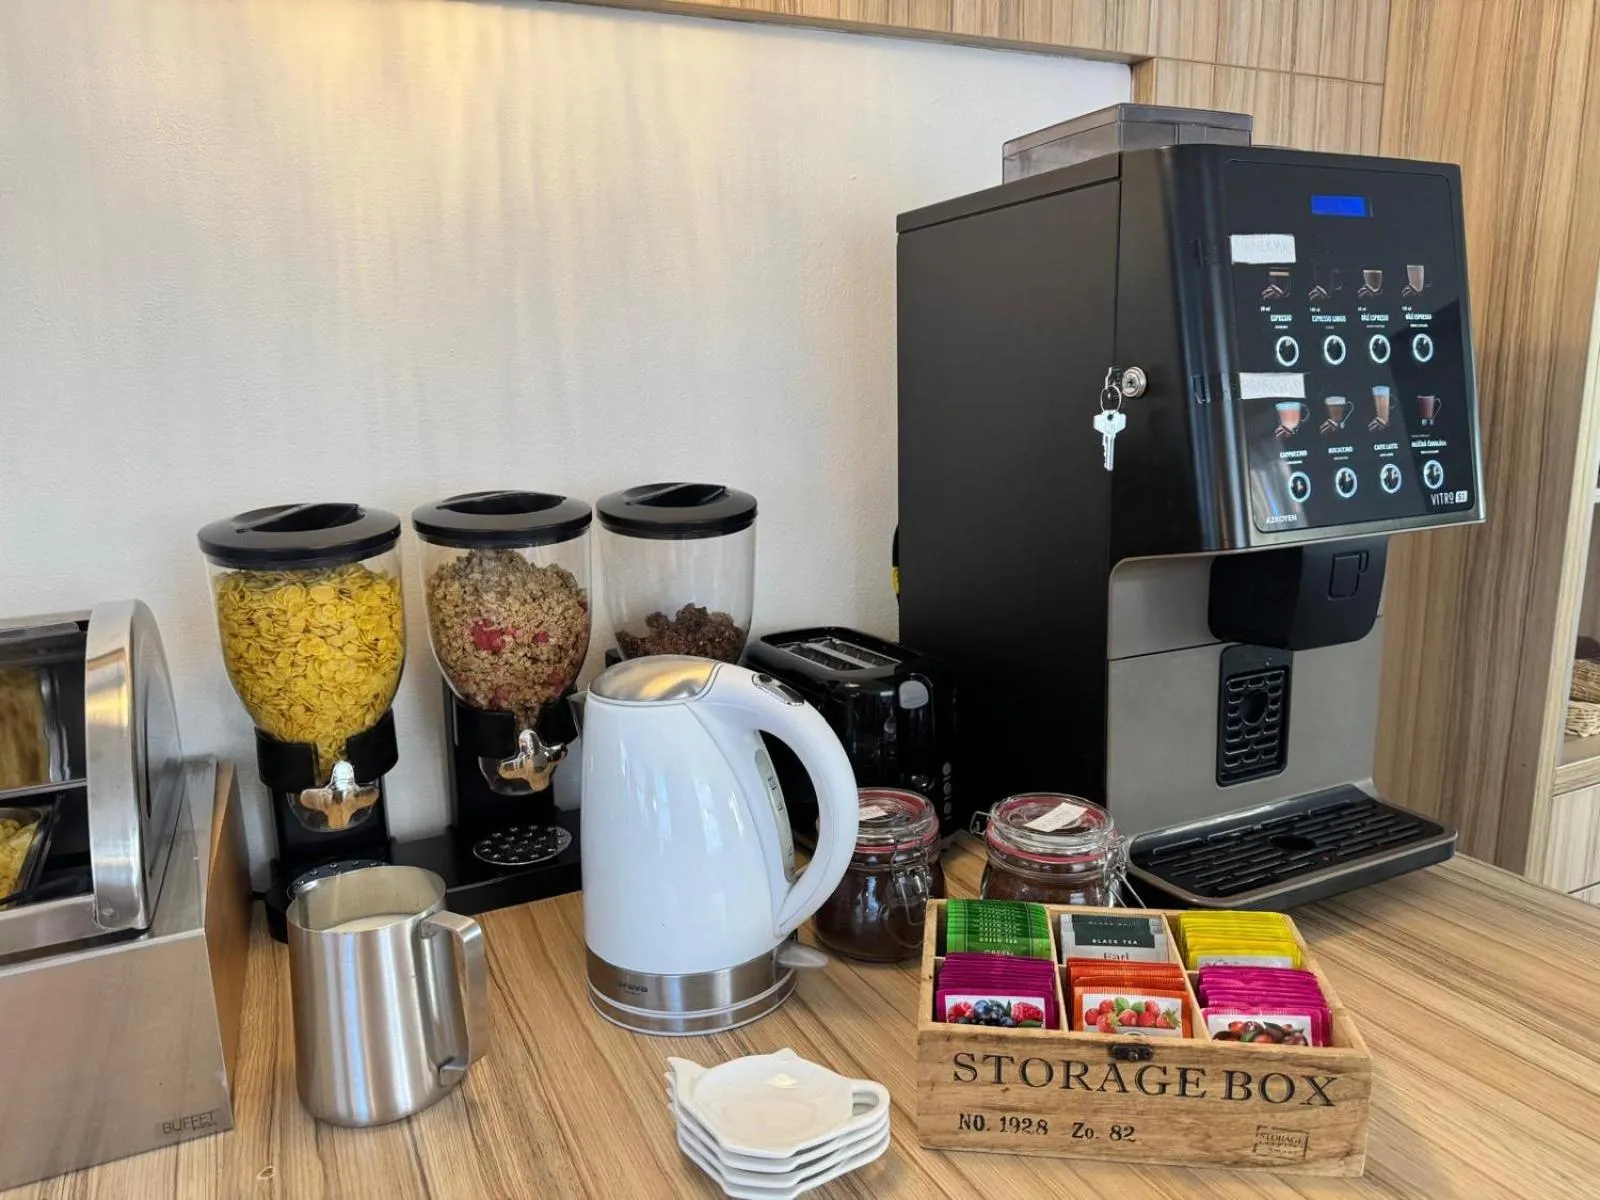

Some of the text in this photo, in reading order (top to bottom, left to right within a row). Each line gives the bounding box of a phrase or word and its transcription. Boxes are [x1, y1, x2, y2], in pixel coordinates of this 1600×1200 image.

[1266, 514, 1298, 525] AZKOYEN
[952, 1052, 1338, 1107] STORAGE BOX
[162, 1111, 216, 1134] BUFFET
[999, 1115, 1049, 1136] 1928
[1109, 1124, 1137, 1142] 82
